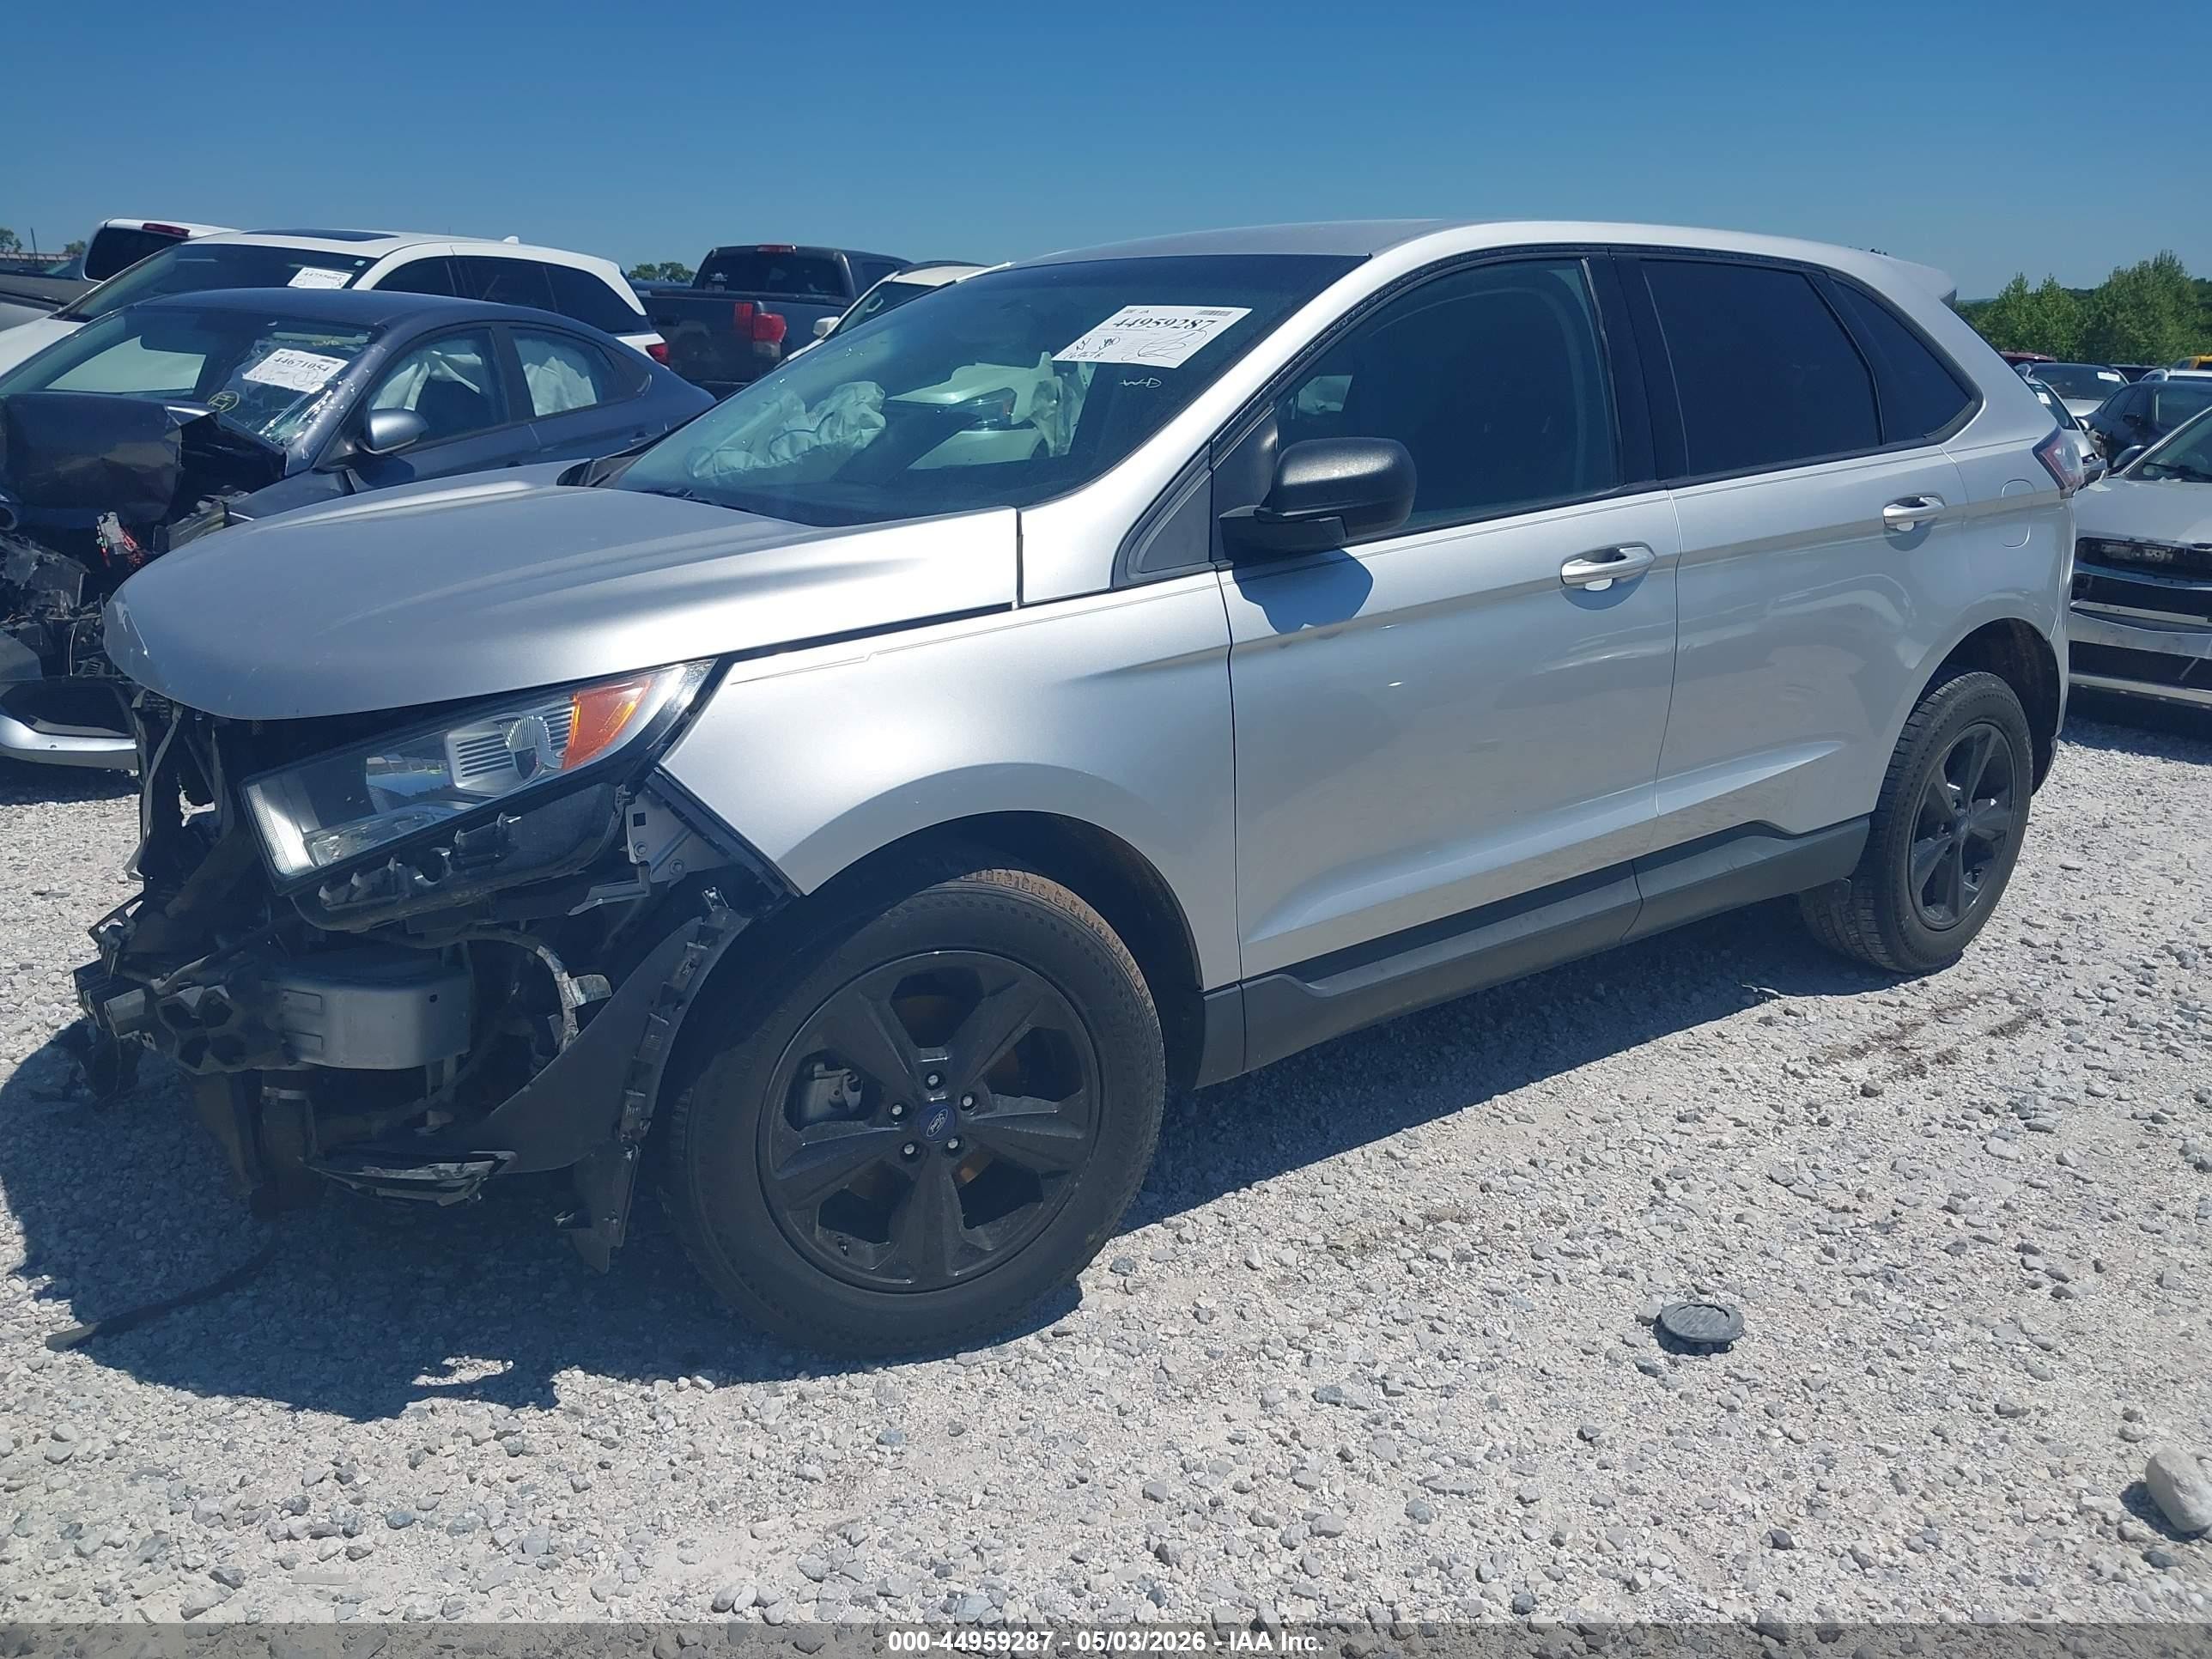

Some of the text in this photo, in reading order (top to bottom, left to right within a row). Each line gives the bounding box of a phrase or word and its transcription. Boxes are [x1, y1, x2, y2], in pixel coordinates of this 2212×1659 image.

[1113, 318, 1218, 331] 44959287
[273, 356, 331, 373] 44671054
[928, 1111, 947, 1134] Ford
